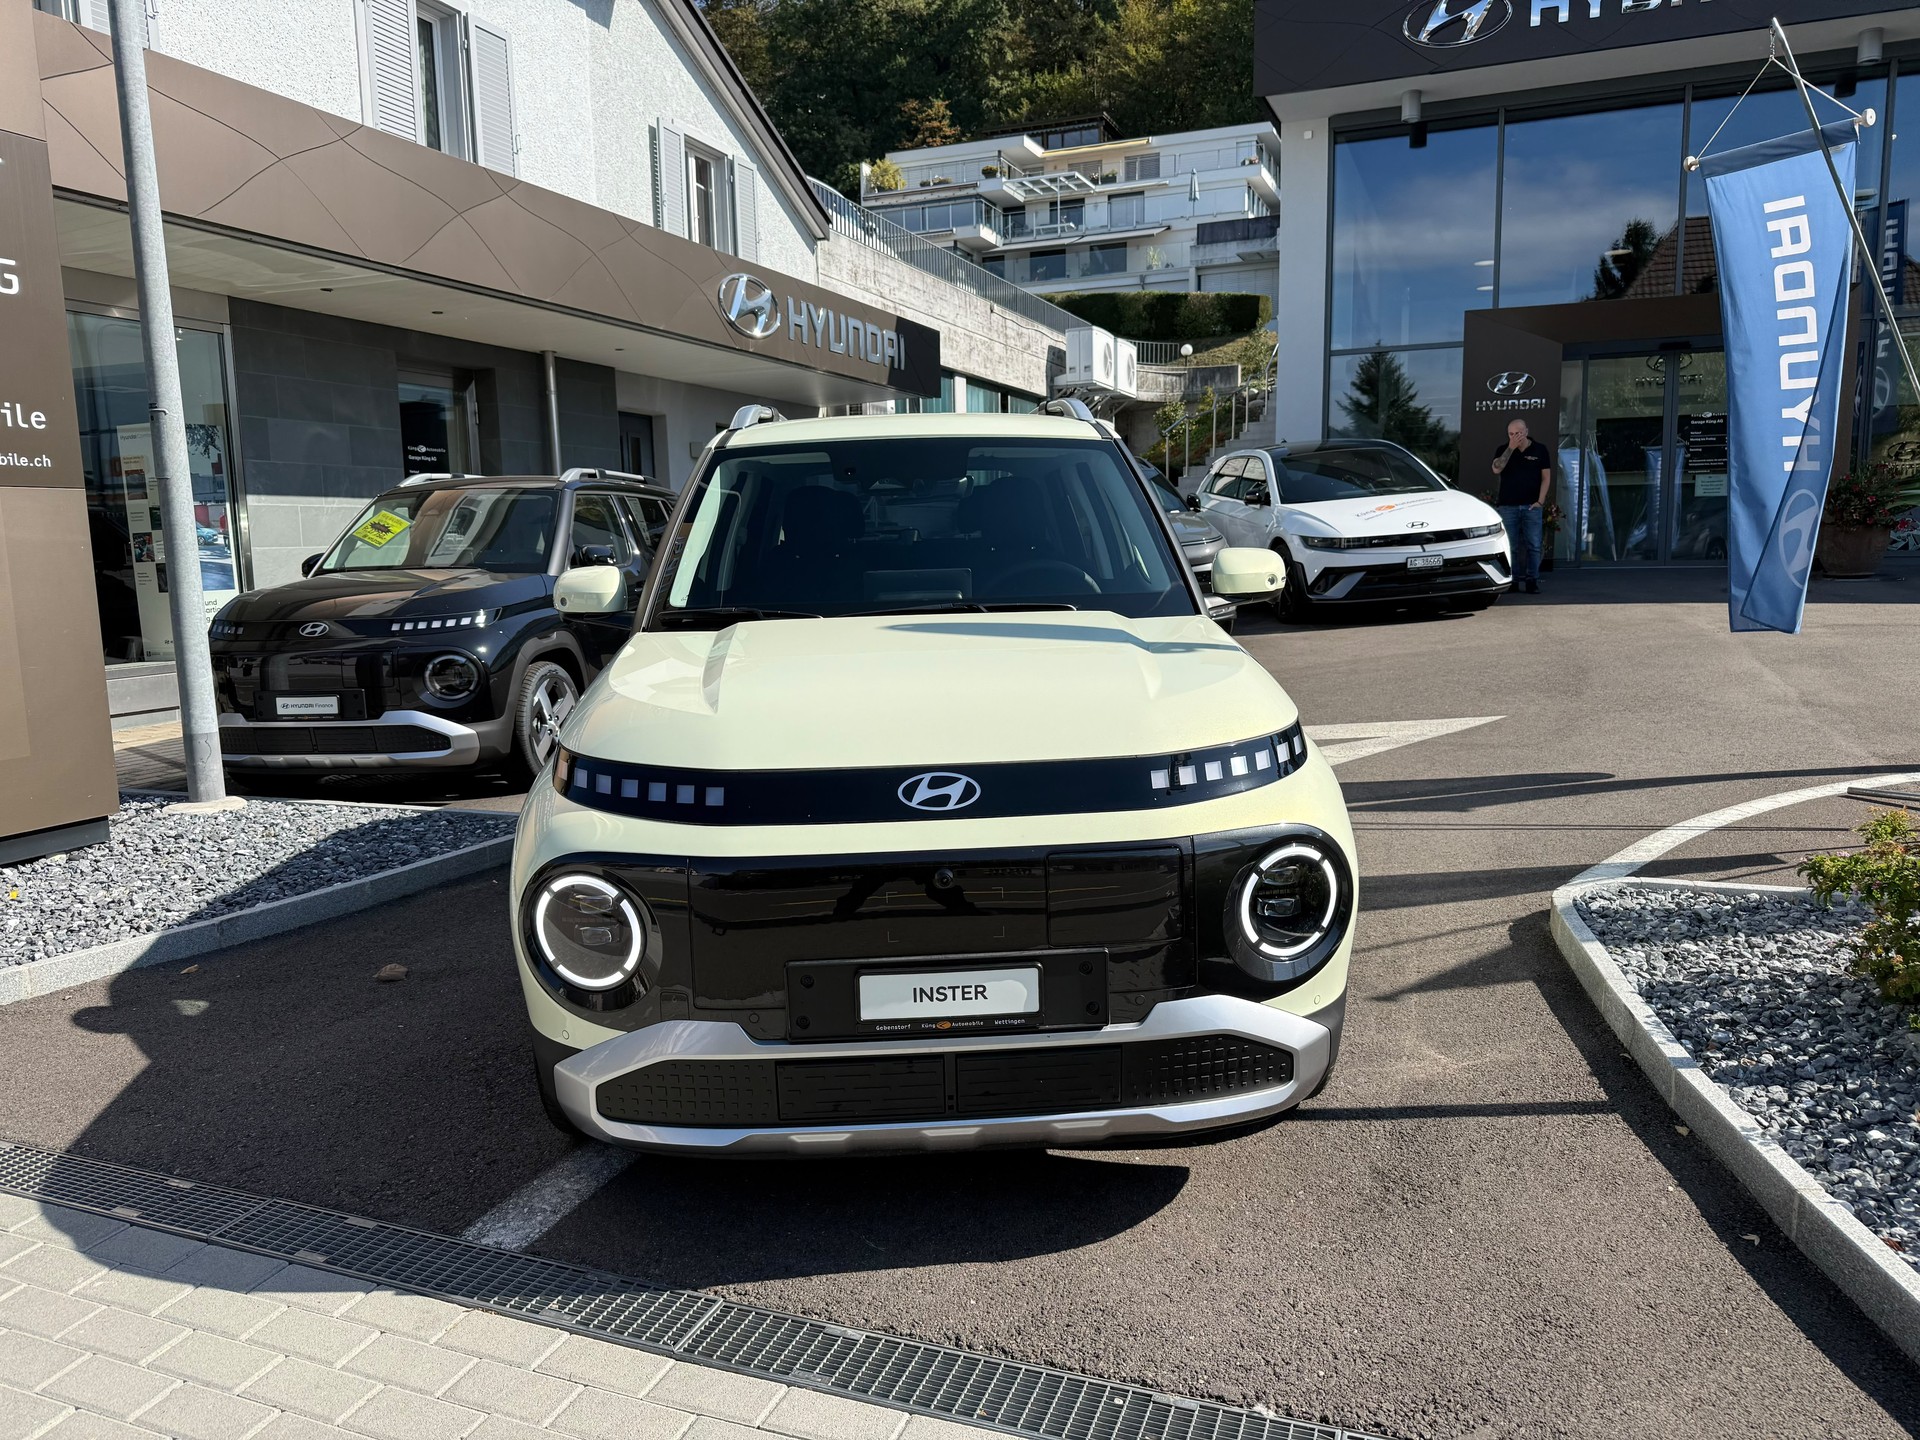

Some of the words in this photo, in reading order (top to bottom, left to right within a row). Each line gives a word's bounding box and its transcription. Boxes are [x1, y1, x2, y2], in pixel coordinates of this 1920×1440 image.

[787, 295, 905, 371] HYUNDAI
[1476, 398, 1546, 412] HYUNDAI
[913, 984, 988, 1003] INSTER
[875, 1023, 911, 1031] Gebenstorf
[921, 1022, 936, 1030] Küng
[951, 1020, 984, 1028] Automobile
[994, 1018, 1026, 1026] Wettingen
